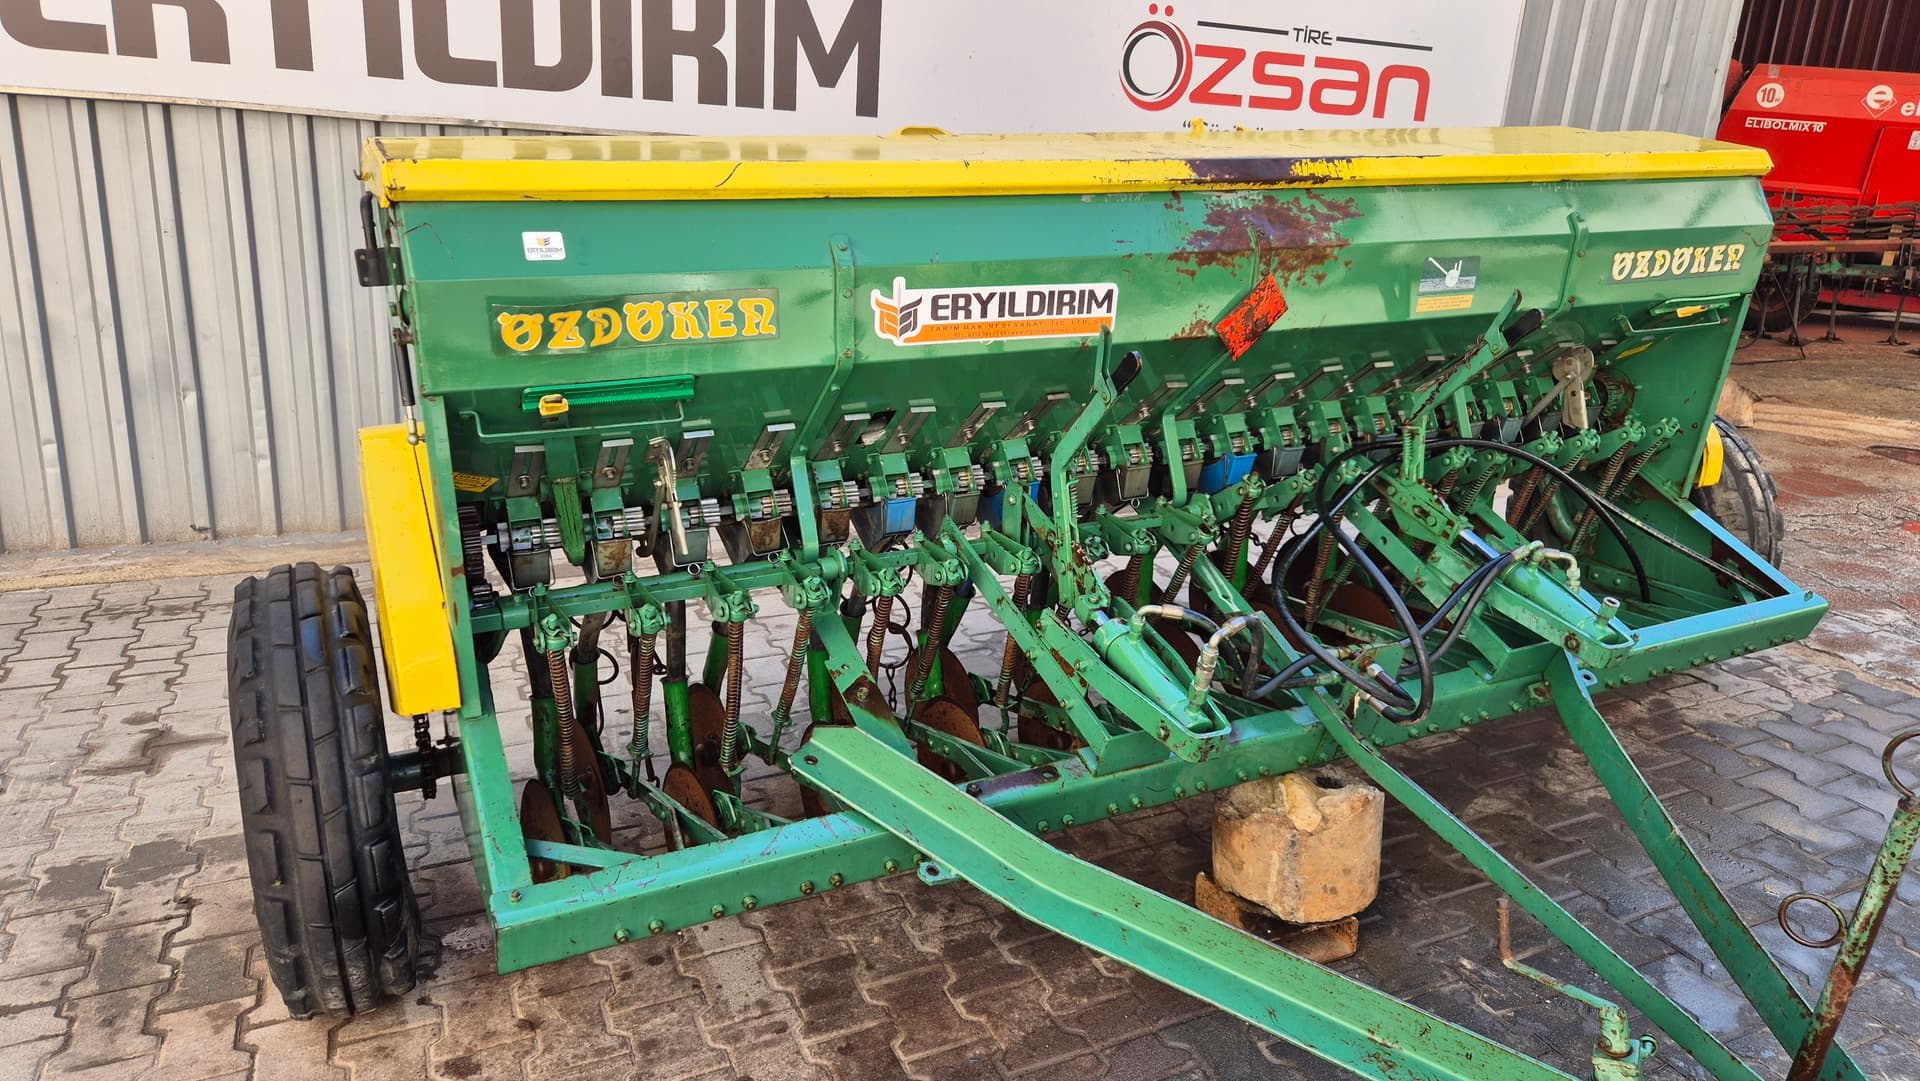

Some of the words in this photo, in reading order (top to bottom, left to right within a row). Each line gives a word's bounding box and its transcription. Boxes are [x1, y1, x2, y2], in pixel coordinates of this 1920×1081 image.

[1293, 25, 1333, 46] TİRE
[0, 0, 880, 118] LDIRIM
[1760, 87, 1777, 103] 10
[931, 288, 1114, 321] ERYILDIRIM
